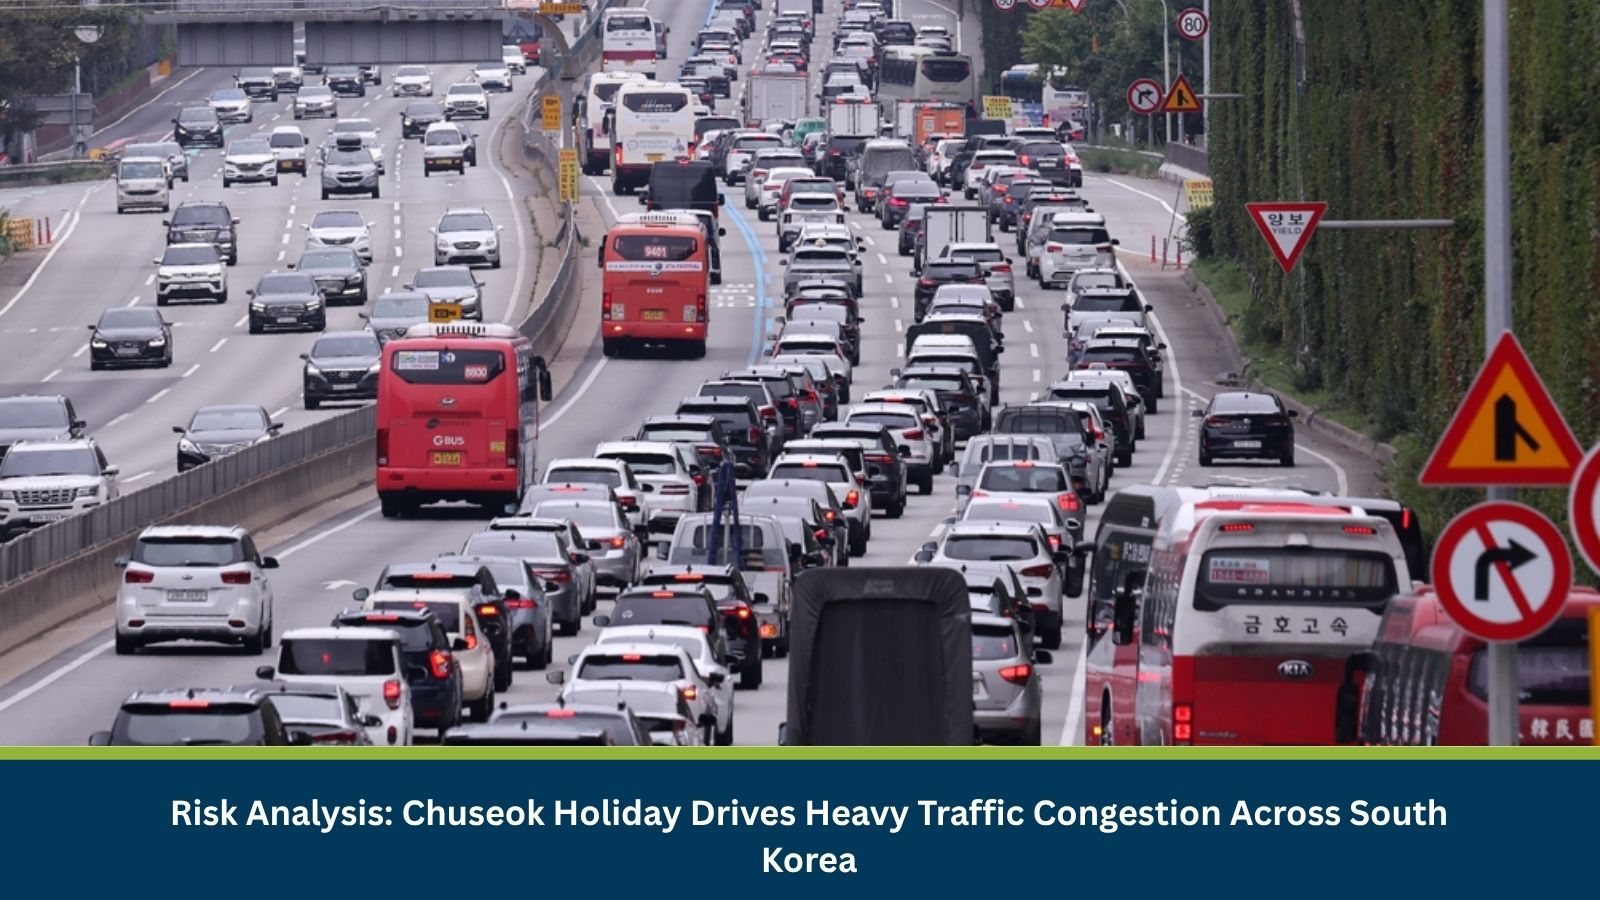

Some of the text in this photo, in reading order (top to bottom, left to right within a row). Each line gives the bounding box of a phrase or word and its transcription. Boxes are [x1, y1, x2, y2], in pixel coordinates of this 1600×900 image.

[1185, 17, 1202, 31] 80
[1269, 213, 1304, 226] 양보
[645, 246, 667, 258] 9401
[465, 366, 487, 378] 8800
[1244, 615, 1349, 636] 금호고속
[1284, 664, 1309, 675] KIA
